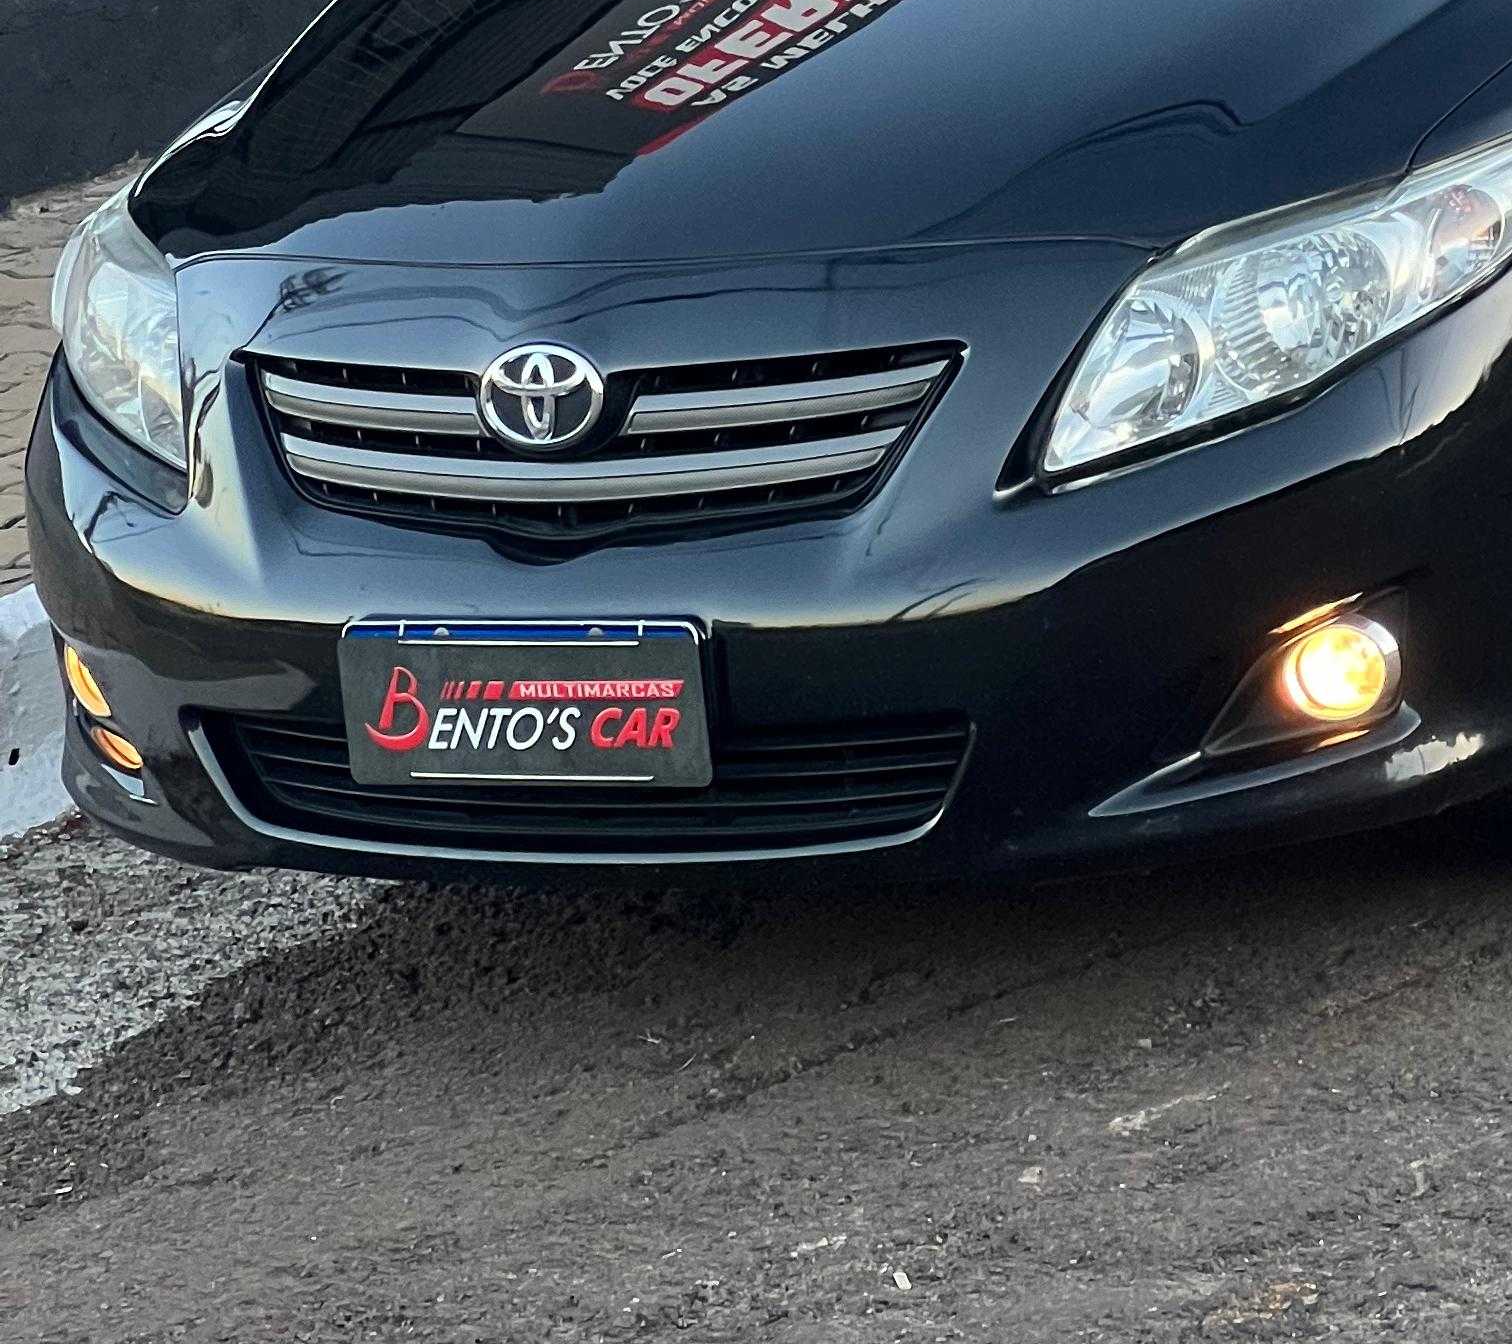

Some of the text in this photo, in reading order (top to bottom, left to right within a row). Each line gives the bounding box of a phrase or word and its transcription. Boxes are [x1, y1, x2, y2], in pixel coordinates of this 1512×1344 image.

[364, 665, 681, 752] BENTO'S CAR
[519, 681, 676, 698] MULTIMARCAS
